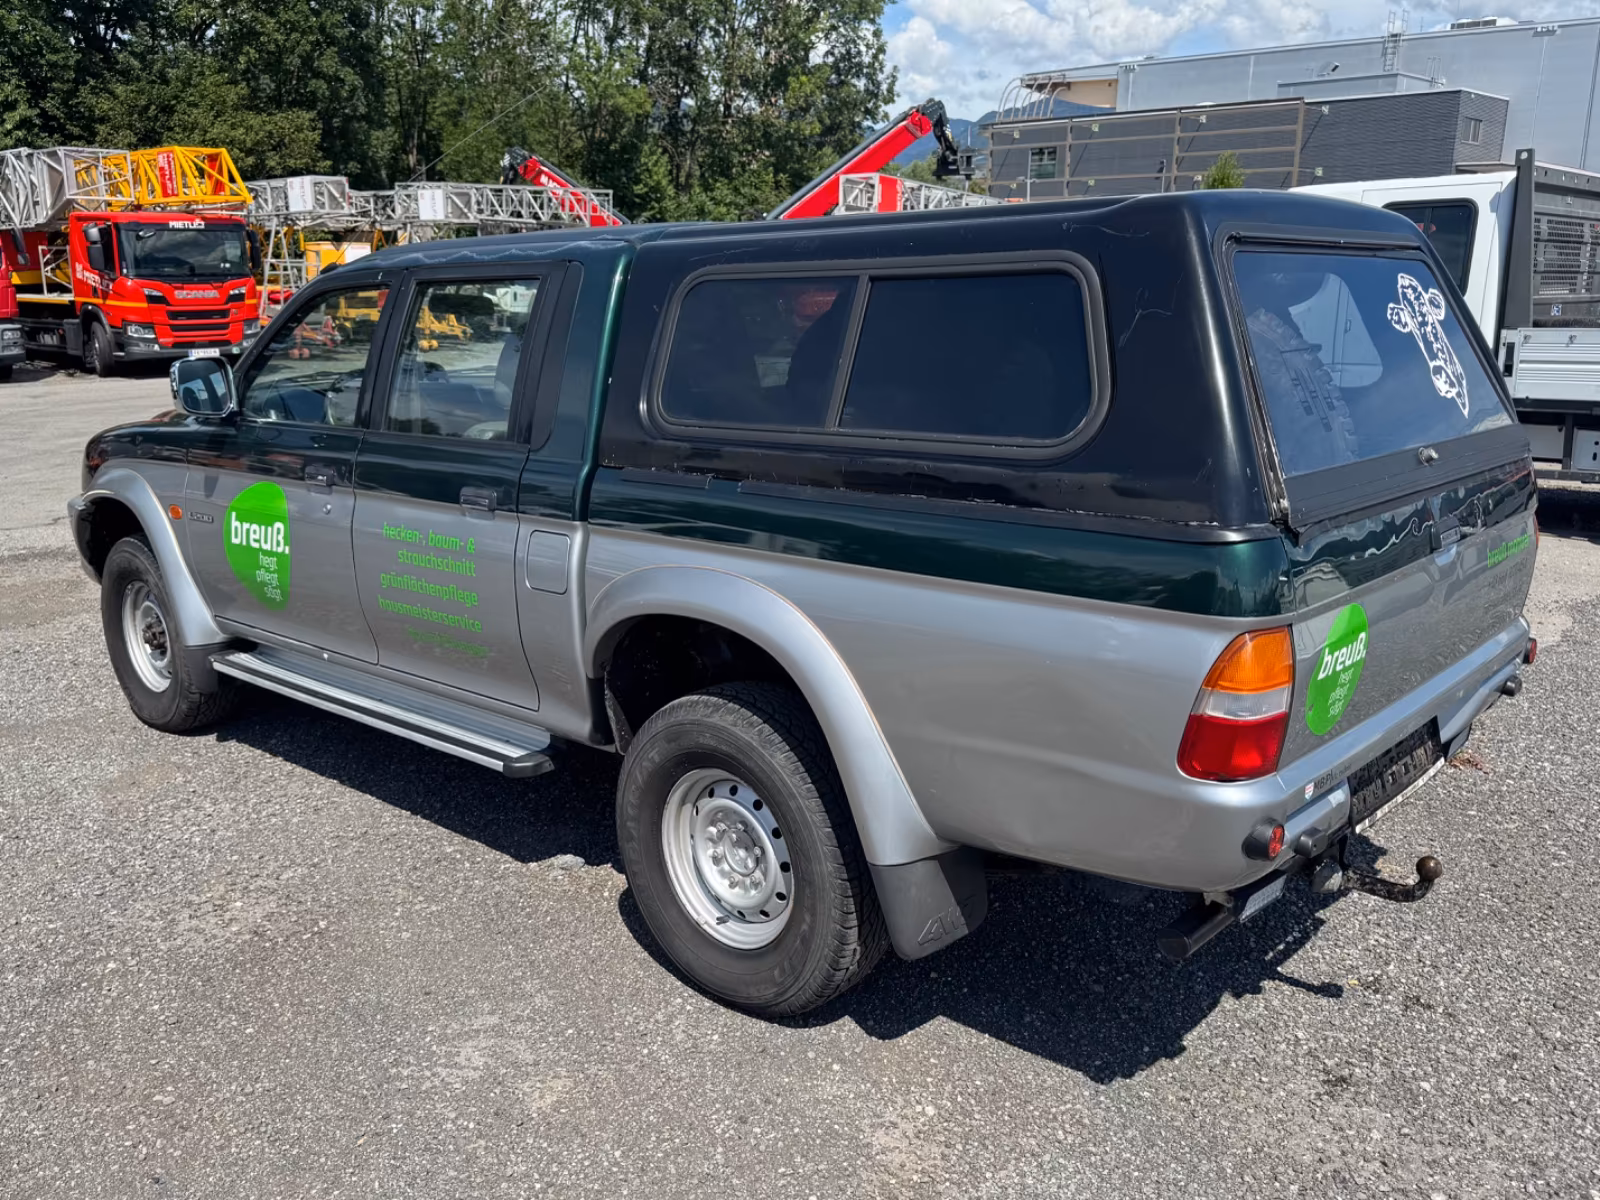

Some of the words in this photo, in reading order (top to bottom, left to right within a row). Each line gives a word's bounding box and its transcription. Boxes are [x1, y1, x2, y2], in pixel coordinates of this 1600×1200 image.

[174, 290, 220, 298] SCANIA
[231, 511, 290, 554] breuß.
[383, 522, 426, 546] hecken-,
[428, 529, 465, 551] baum-
[467, 537, 475, 554] &
[256, 568, 280, 587] pflegt
[260, 552, 278, 571] hegt
[398, 548, 476, 577] strauchschnitt
[380, 571, 479, 608] grünflächenpflege
[378, 594, 482, 633] hausmeisterservice
[1317, 631, 1367, 680] breuß.
